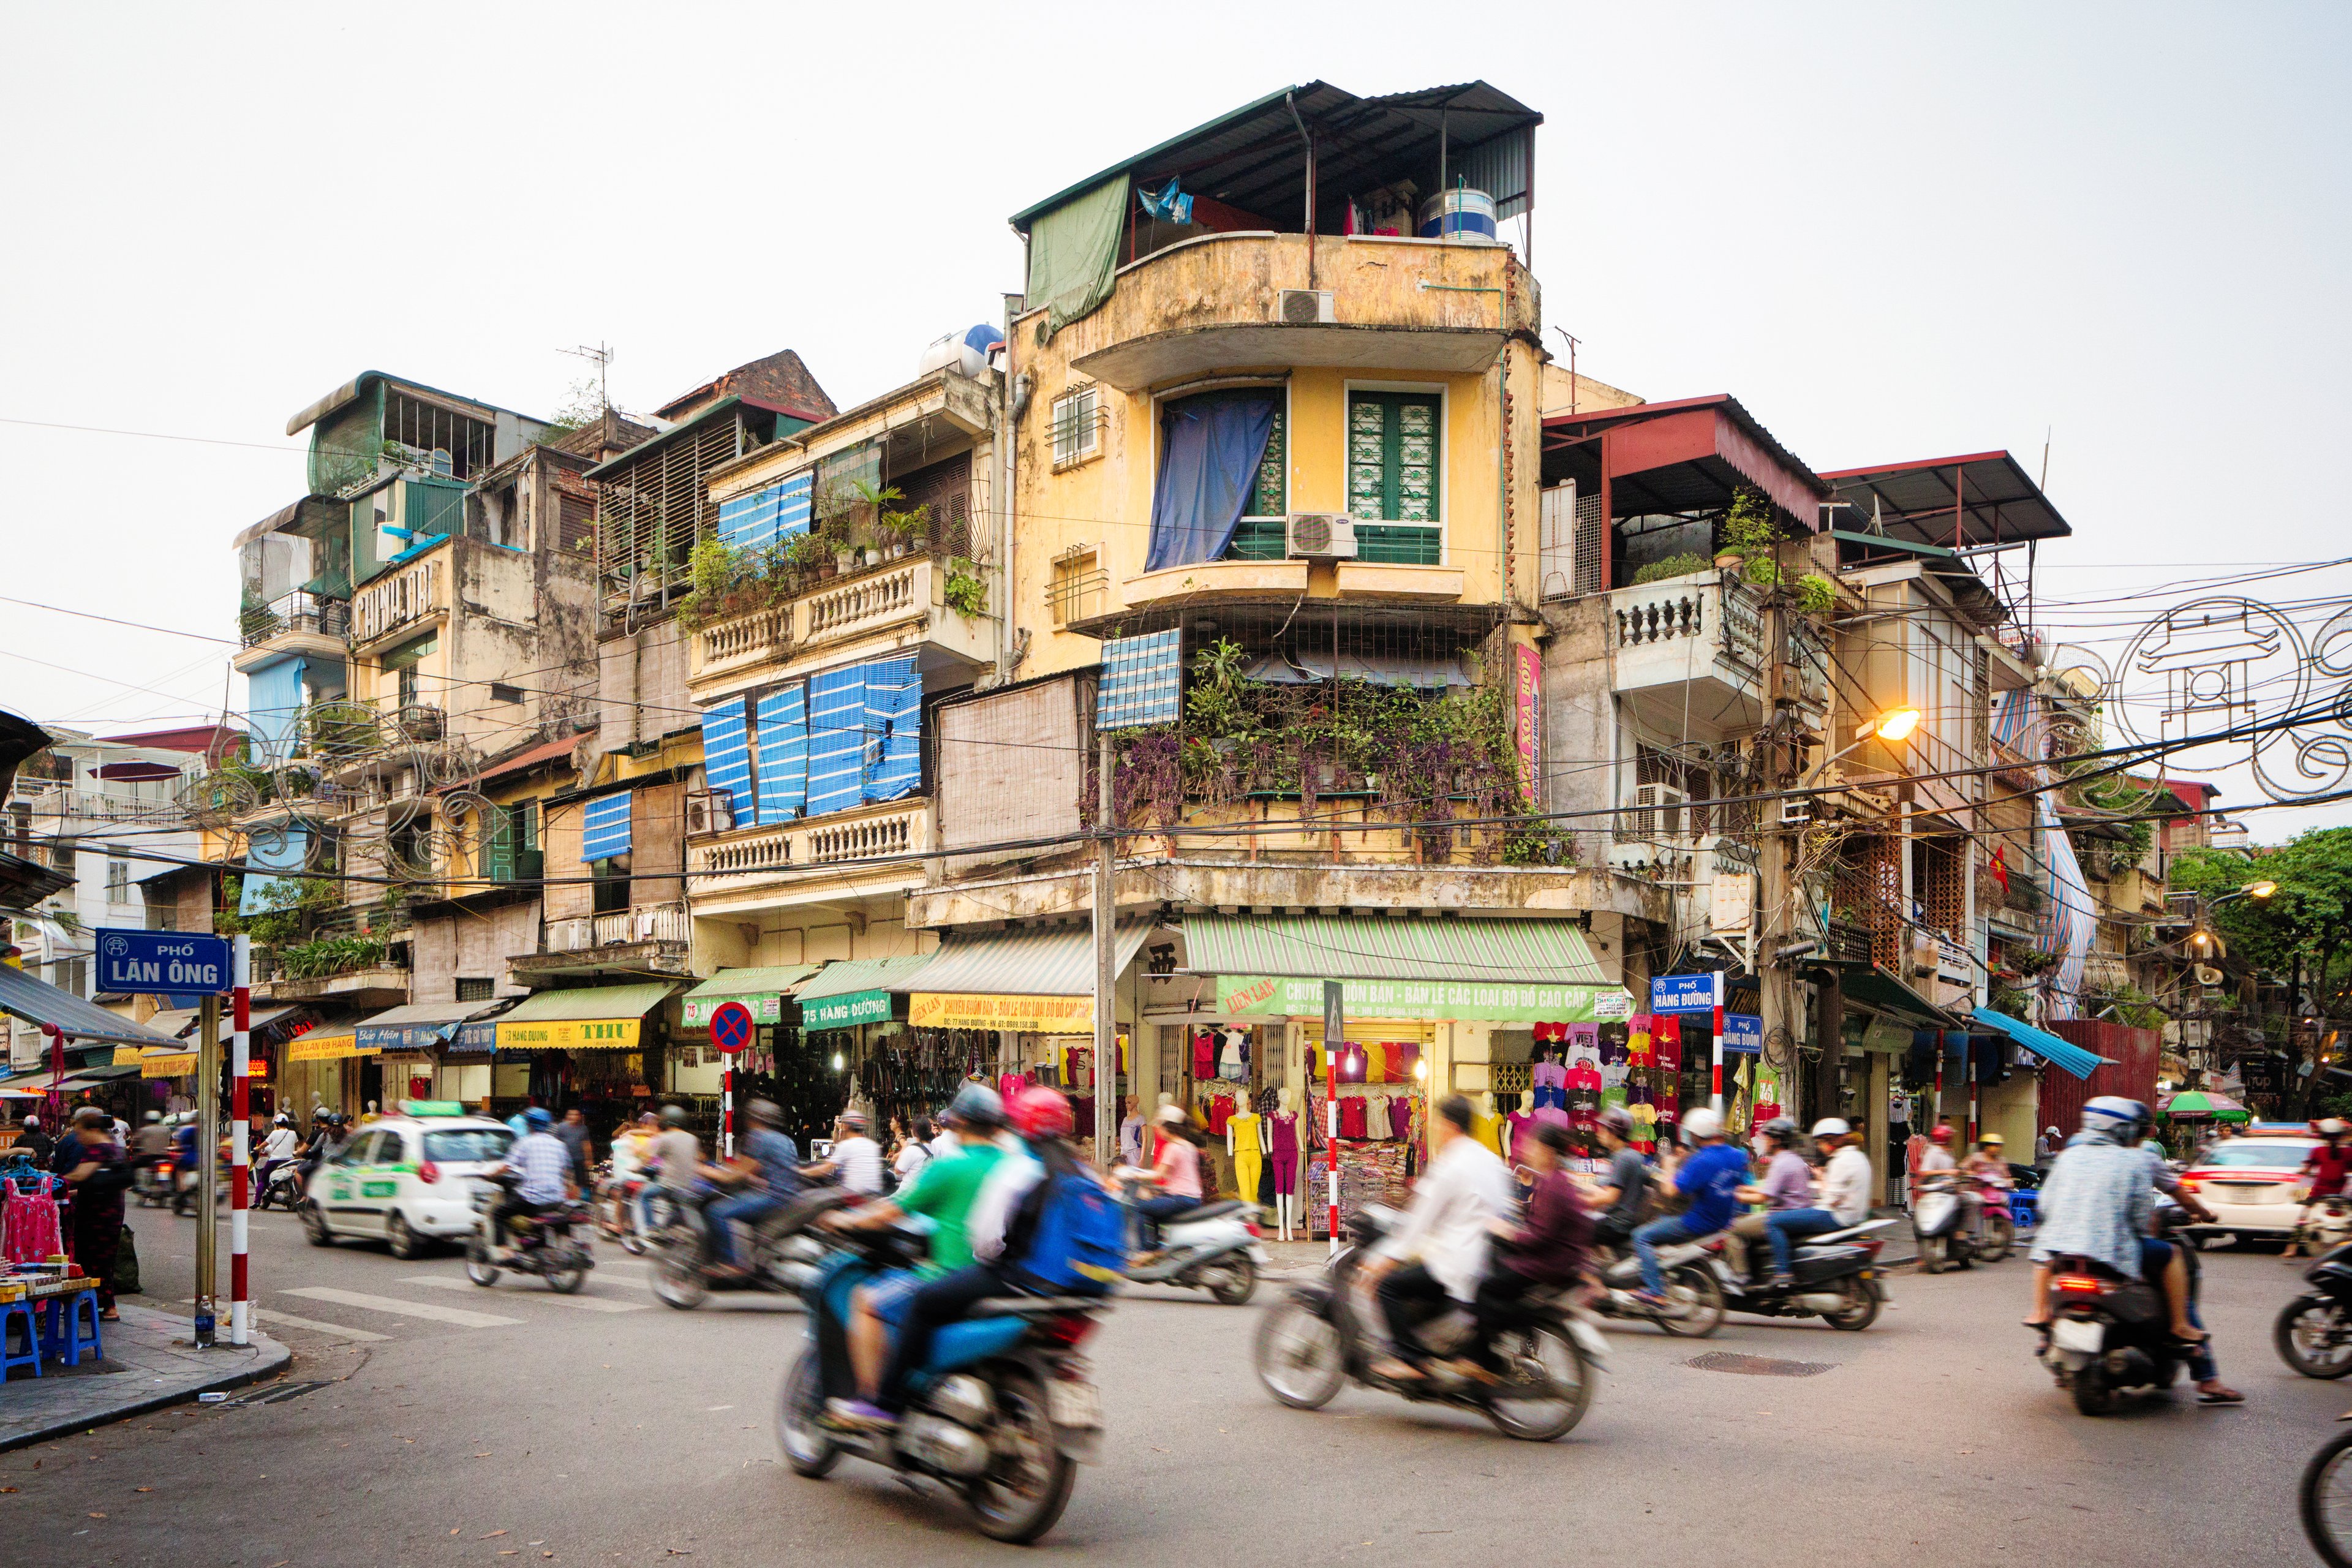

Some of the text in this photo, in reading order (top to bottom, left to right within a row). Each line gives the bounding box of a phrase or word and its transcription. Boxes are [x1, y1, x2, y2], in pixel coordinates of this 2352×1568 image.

[1522, 704, 1531, 747] XOA
[157, 942, 194, 956] PHỐ
[113, 958, 217, 984] LÃN ÔNG
[1679, 980, 1697, 989] PHỐ
[1226, 978, 1276, 1014] LIÊN LAN
[1287, 981, 1324, 1001] CHUYÊ
[1343, 981, 1366, 1003] UÔN
[1474, 989, 1499, 1010] LOẠI
[1539, 990, 1561, 1008] CAO
[1655, 993, 1679, 1007] HÀNG
[1681, 989, 1711, 1006] ĐƯỜNG
[687, 1005, 696, 1018] 75
[803, 1010, 816, 1023] 75
[820, 1005, 848, 1021] HÀNG
[926, 996, 941, 1014] LAN
[580, 1023, 633, 1039] THU
[1723, 1029, 1741, 1045] HÀNG
[305, 1041, 320, 1052] LAN
[322, 1039, 330, 1049] 69
[332, 1037, 352, 1049] HÀNG
